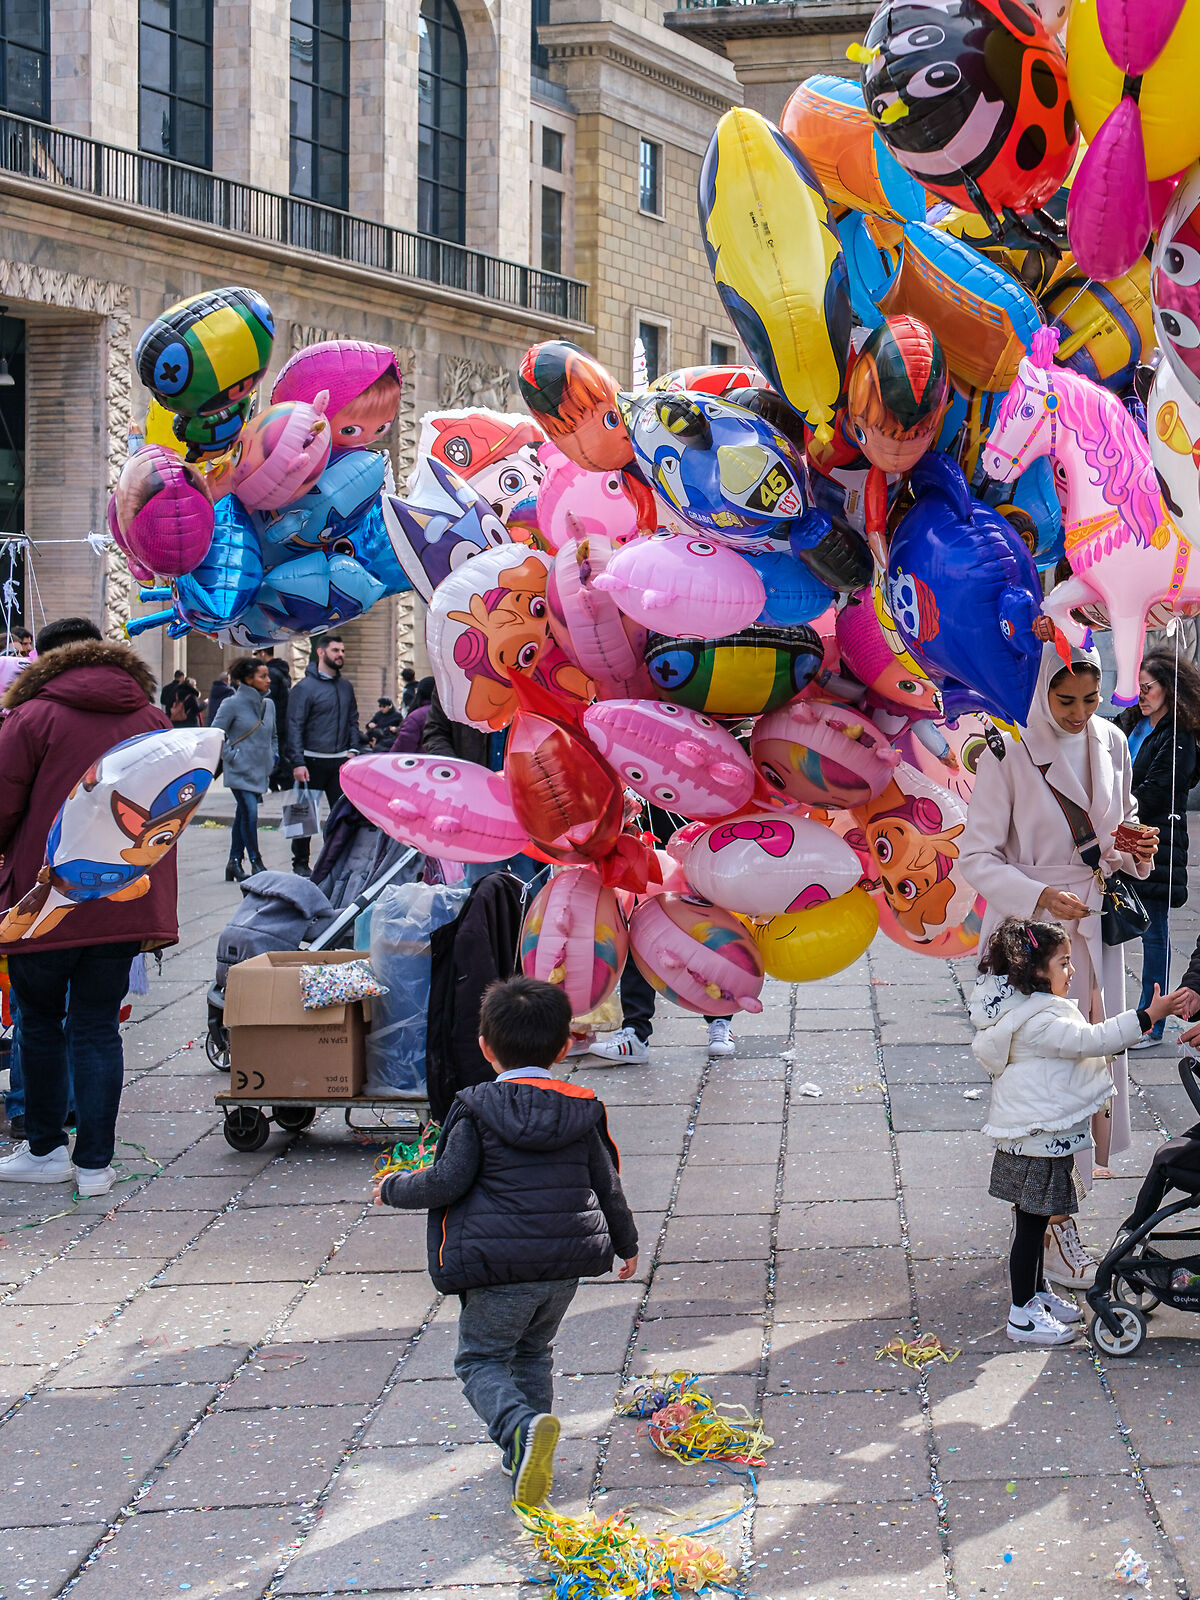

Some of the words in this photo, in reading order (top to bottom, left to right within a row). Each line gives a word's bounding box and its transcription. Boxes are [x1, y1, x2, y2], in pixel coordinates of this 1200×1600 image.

[760, 468, 788, 507] 45
[778, 489, 801, 515] FIST
[688, 510, 714, 525] GRABO
[318, 1036, 329, 1044] NV
[1180, 1296, 1199, 1304] cybex
